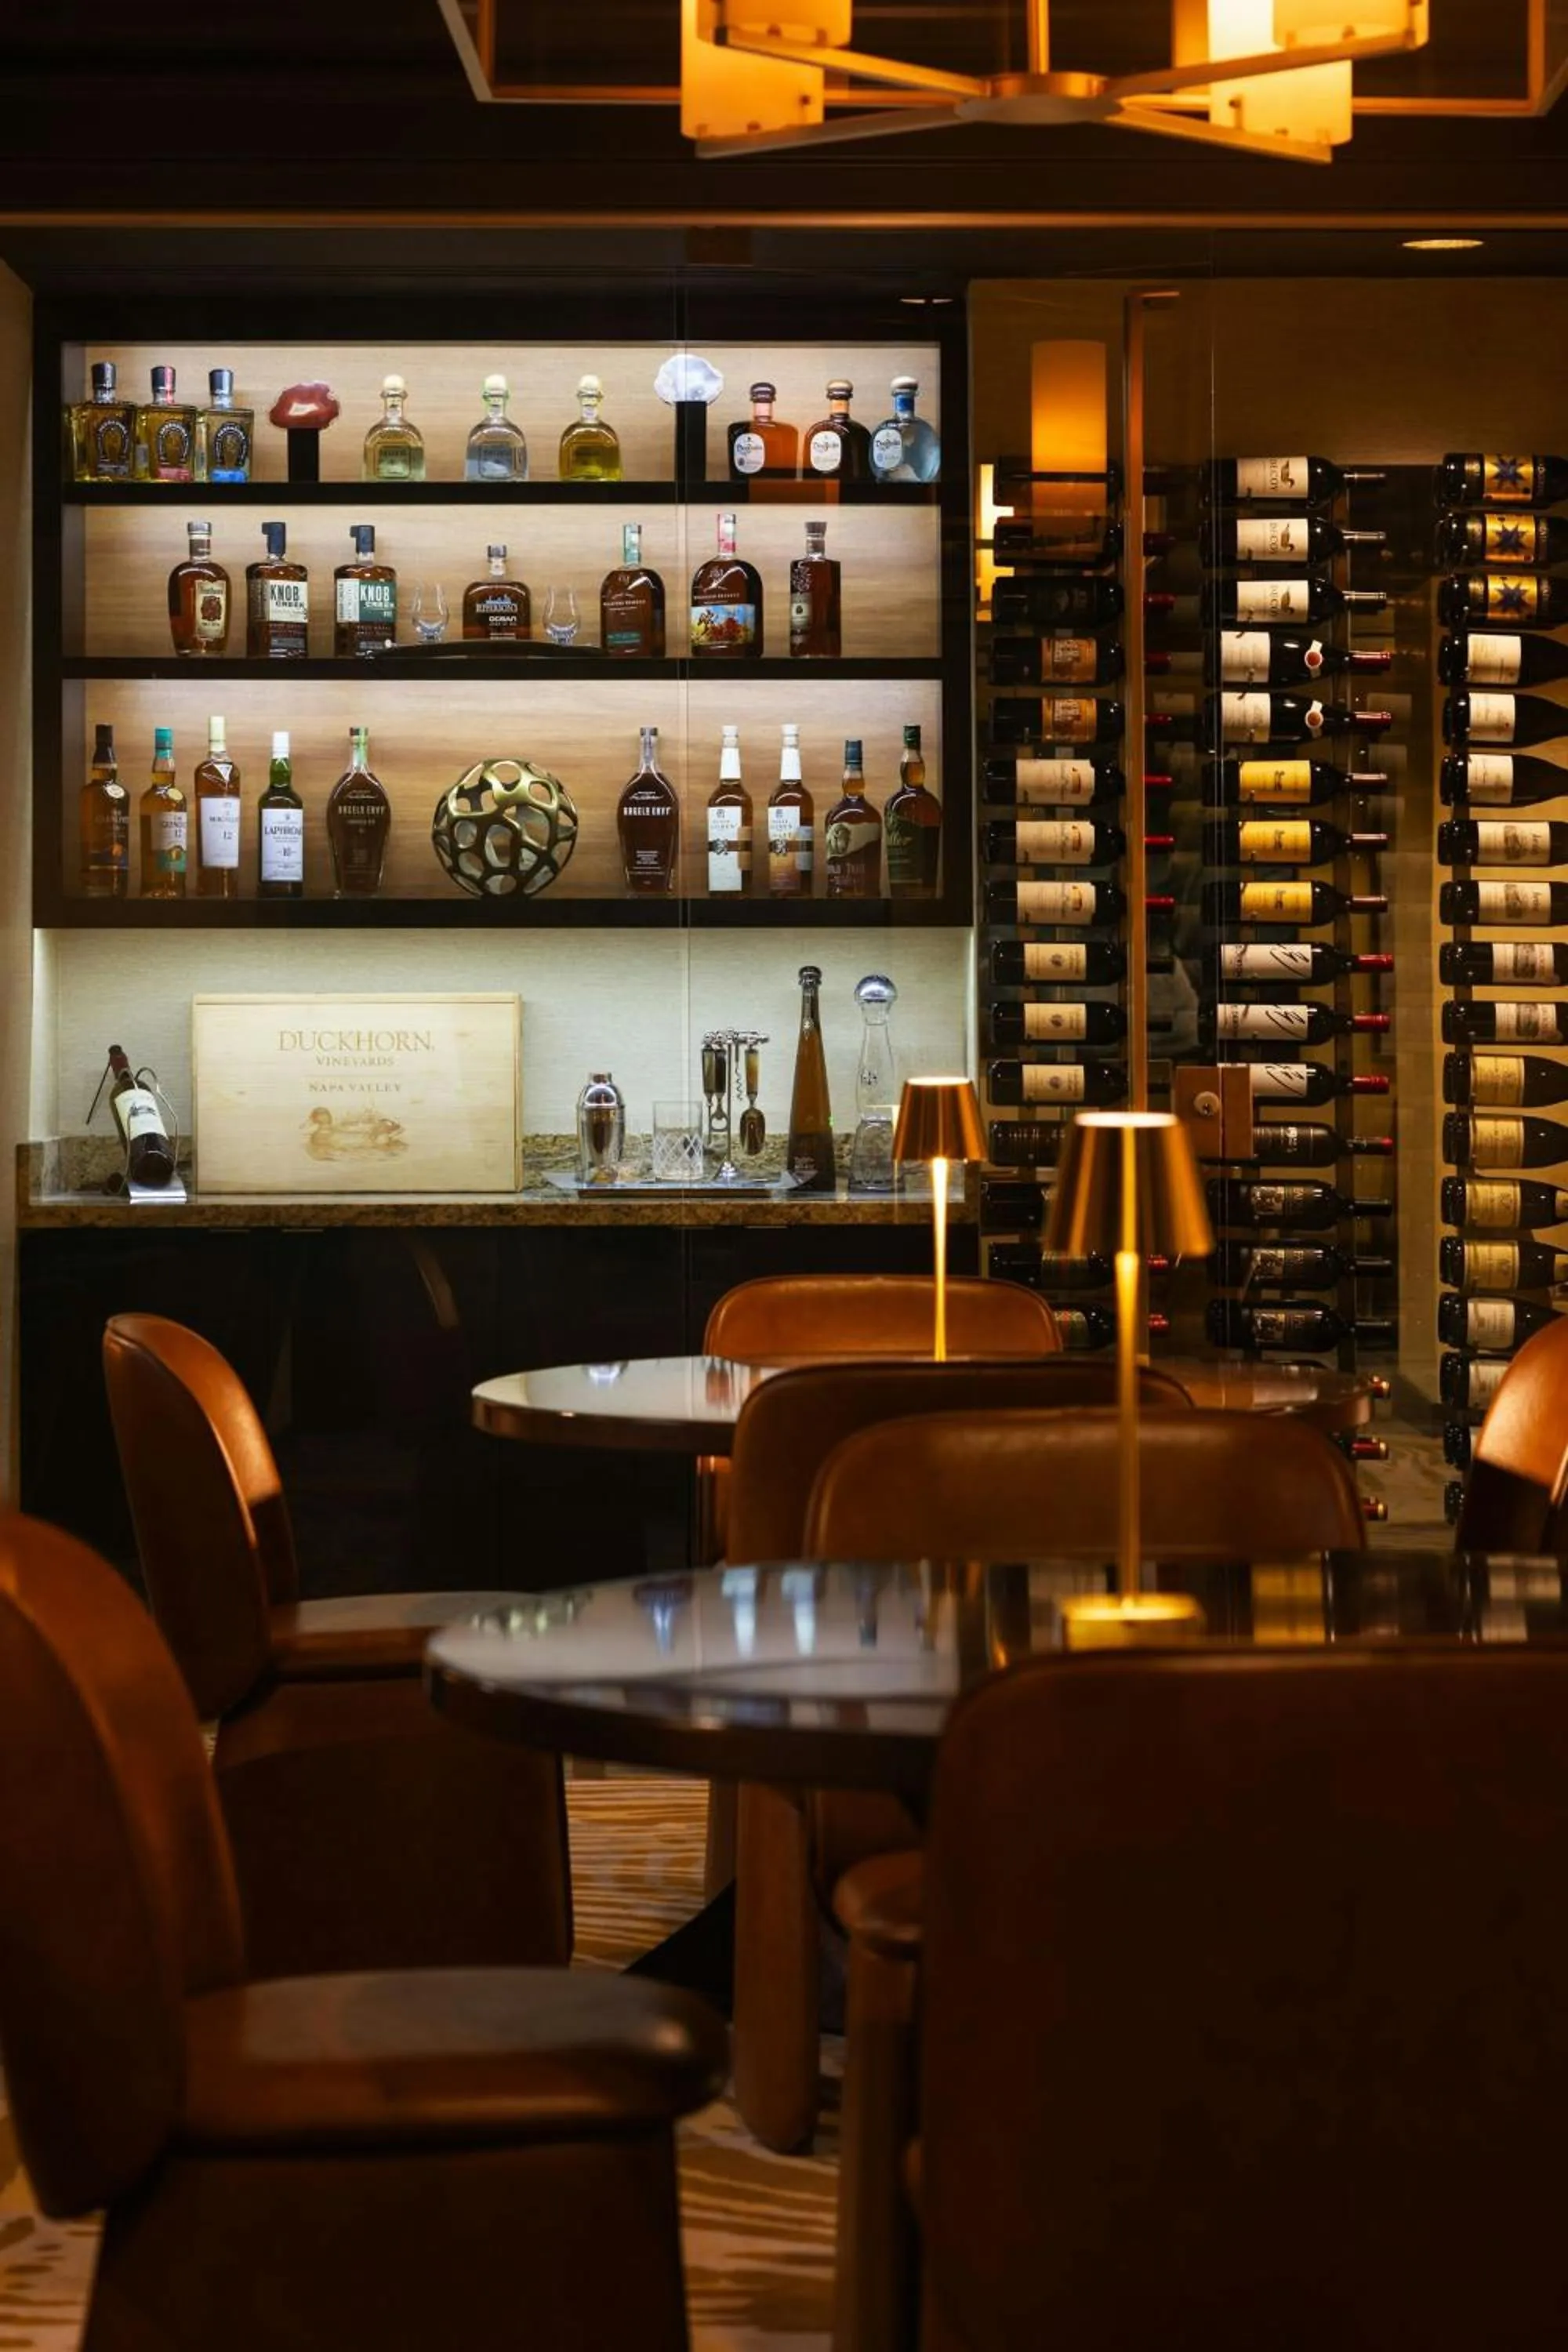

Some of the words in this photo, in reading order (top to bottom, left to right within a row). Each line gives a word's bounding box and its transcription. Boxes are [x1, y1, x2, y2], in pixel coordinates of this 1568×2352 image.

[270, 584, 299, 601] KNOB
[360, 584, 390, 601] KNOB
[316, 1055, 396, 1067] VINEYARDS
[308, 1083, 344, 1092] NAPA
[348, 1082, 403, 1092] VALLEY
